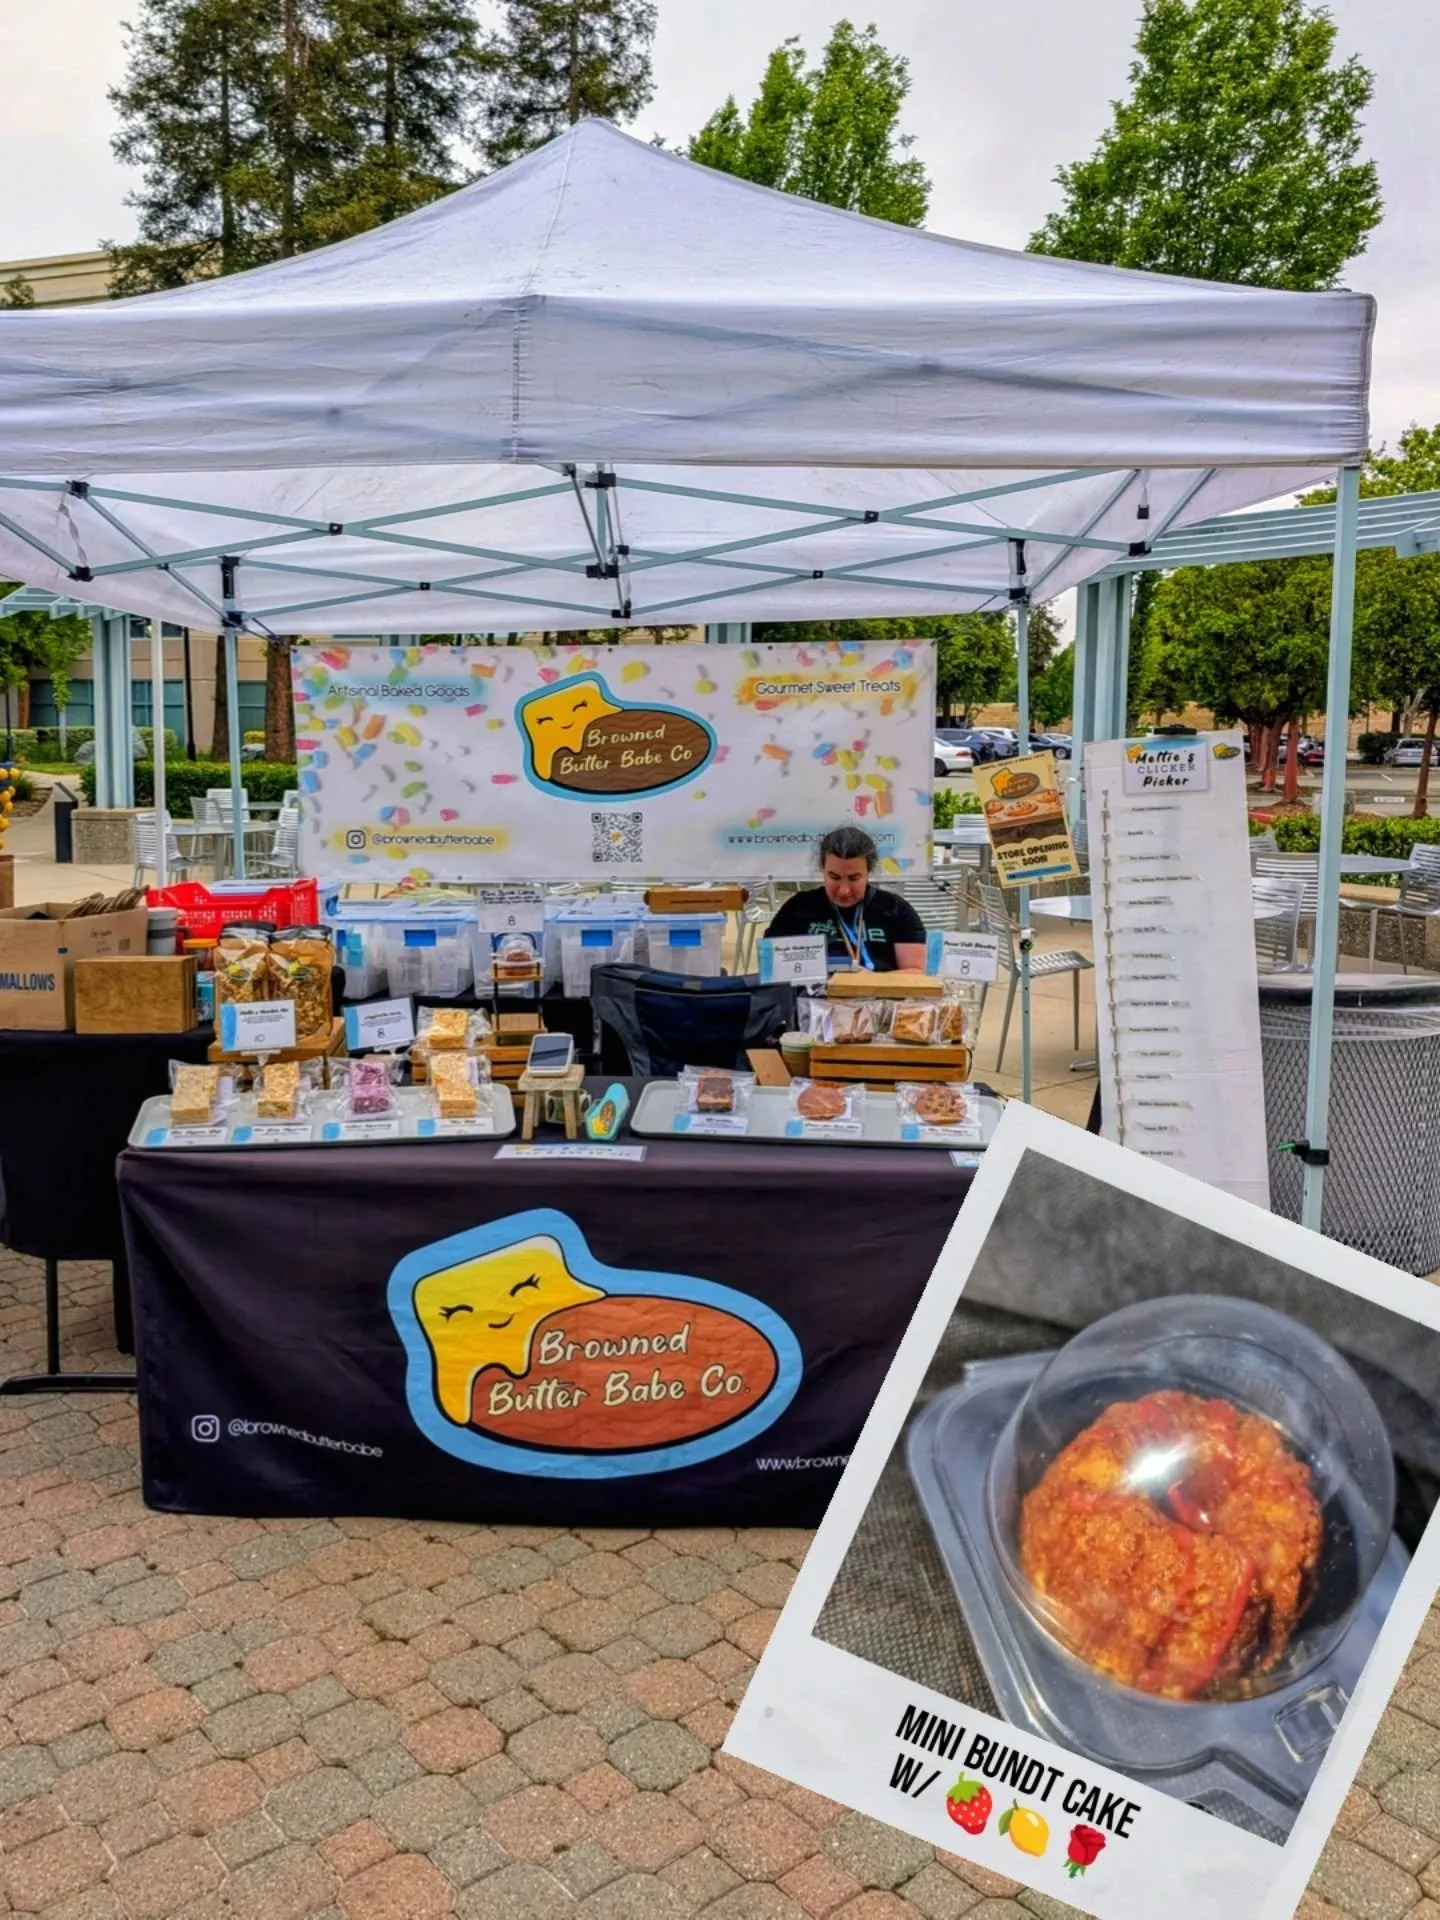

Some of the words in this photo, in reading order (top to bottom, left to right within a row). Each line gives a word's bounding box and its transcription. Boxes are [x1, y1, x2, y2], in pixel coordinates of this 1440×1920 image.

[381, 684, 422, 697] Baked
[425, 684, 470, 698] Goods
[756, 682, 814, 694] Gourmet
[817, 681, 856, 693] Sweet
[860, 680, 901, 692] Treats
[587, 723, 666, 747] Browned
[560, 755, 612, 775] Butter
[620, 750, 663, 769] Babe
[670, 744, 693, 762] Co
[1137, 763, 1196, 774] CLICKER
[1143, 775, 1190, 788] Picker
[372, 833, 495, 846] @brownedbutterbabe
[997, 848, 1026, 861] STORE
[1027, 841, 1069, 856] OPENING
[1022, 855, 1048, 867] SOON
[960, 960, 971, 975] 8
[0, 972, 56, 991] MALLOWS
[538, 1321, 692, 1365] Browned
[488, 1378, 589, 1416] Butter
[603, 1368, 685, 1407] Babe
[228, 1418, 384, 1457] @brownedbutterbabe
